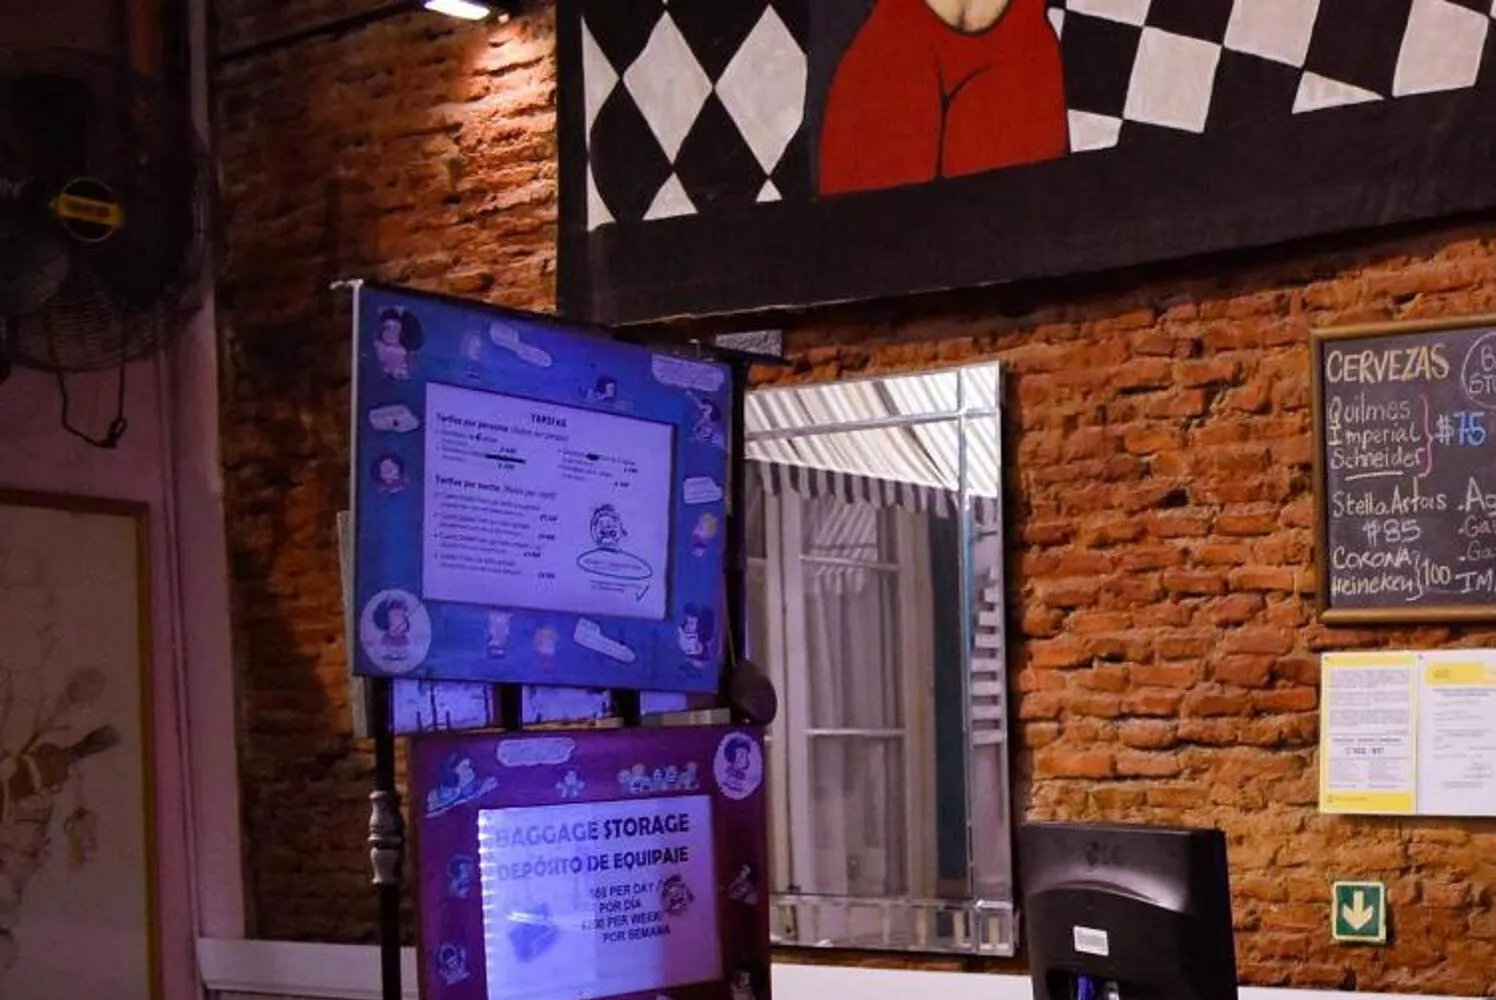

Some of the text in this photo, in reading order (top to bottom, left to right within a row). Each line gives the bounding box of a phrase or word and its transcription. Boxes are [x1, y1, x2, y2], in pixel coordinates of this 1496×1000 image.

[1326, 343, 1451, 384] CERVEZAS
[1329, 391, 1412, 424] Quilmes
[1330, 446, 1427, 470] Schneider
[495, 812, 690, 849] BAGGAGE STORAGE
[587, 853, 610, 872] DE
[613, 846, 689, 869] EQUIPAJE
[609, 883, 631, 897] PER
[599, 901, 621, 913] POR
[603, 931, 625, 943] POR
